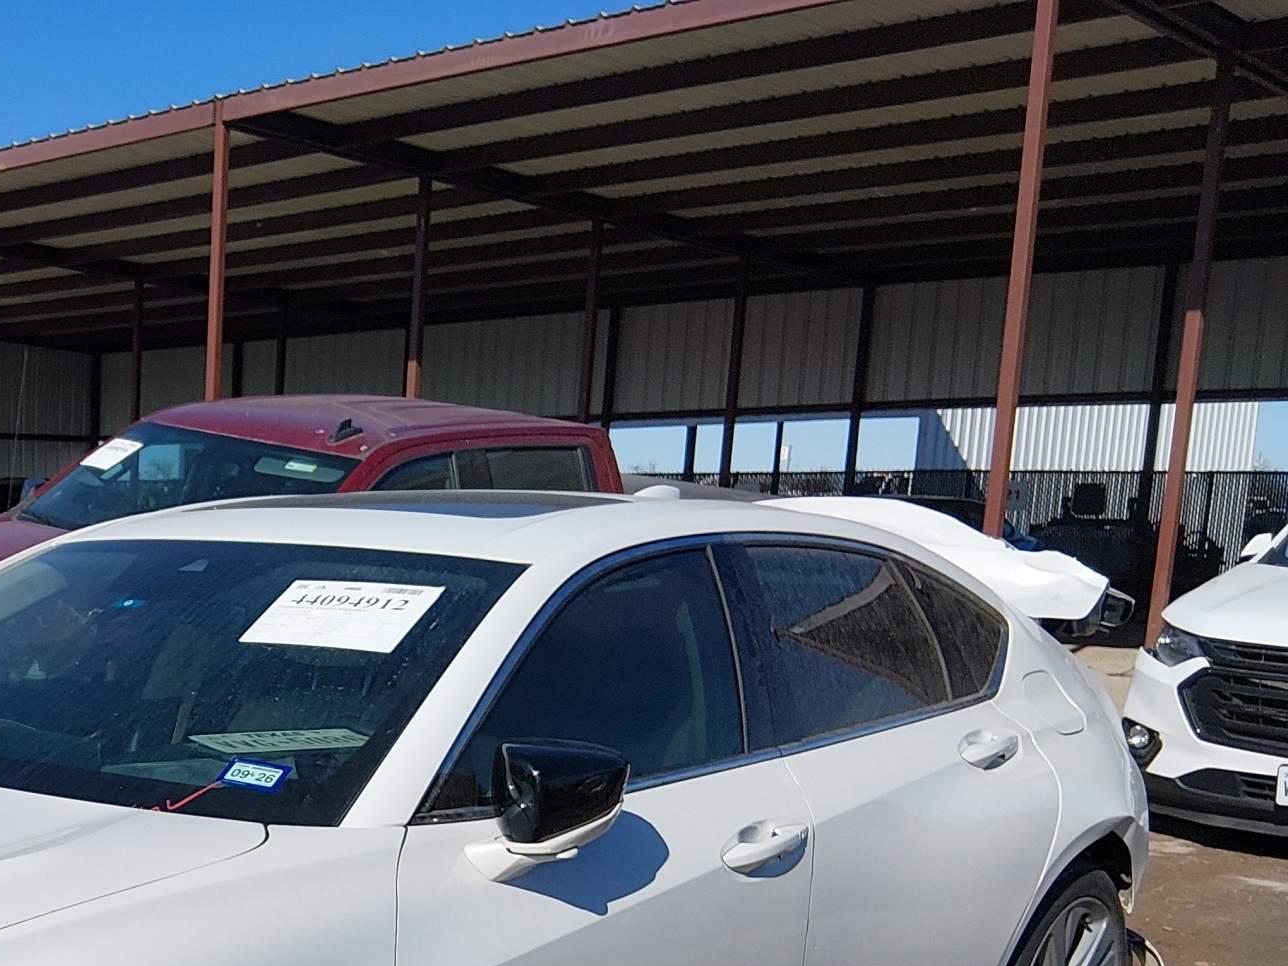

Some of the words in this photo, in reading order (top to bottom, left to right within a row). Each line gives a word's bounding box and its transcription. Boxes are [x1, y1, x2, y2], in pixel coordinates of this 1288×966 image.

[291, 593, 410, 611] 44094912
[231, 768, 250, 779] 09
[255, 772, 276, 784] 26
